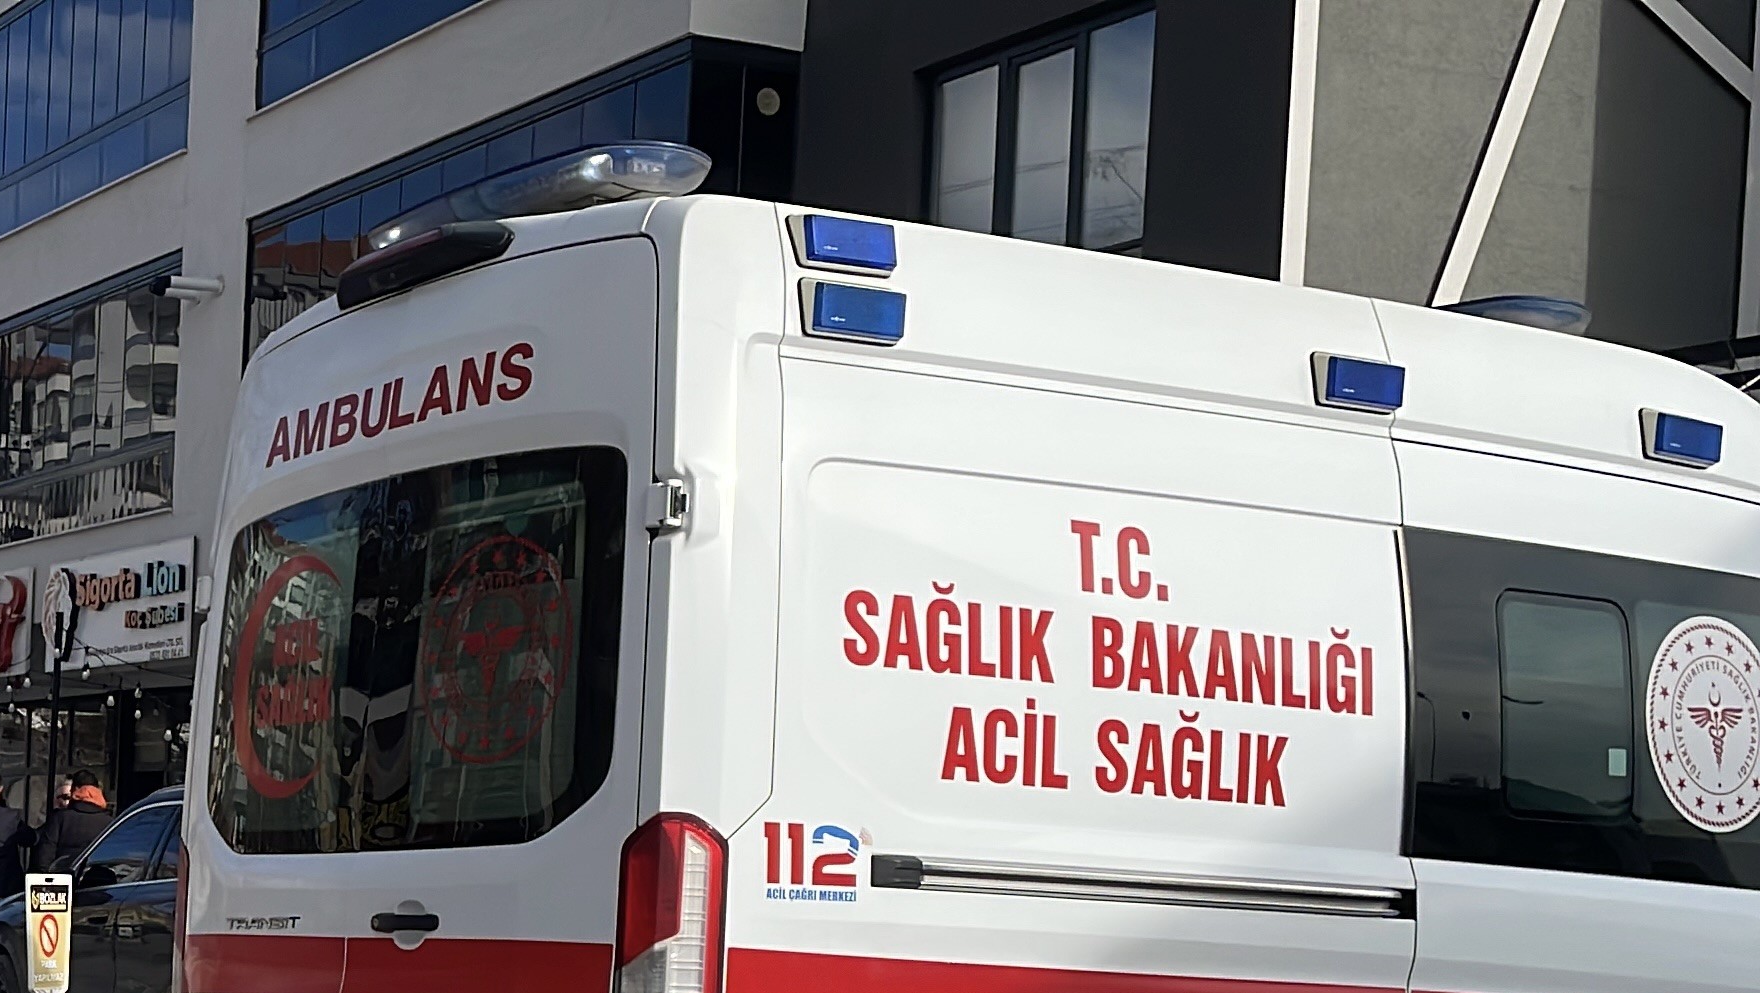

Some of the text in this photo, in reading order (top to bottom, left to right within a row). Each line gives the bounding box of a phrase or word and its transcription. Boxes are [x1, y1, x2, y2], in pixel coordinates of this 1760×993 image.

[265, 342, 534, 468] AMBULANS
[75, 561, 186, 611] Sigorta Lion
[1071, 519, 1167, 599] T.C.
[844, 580, 1372, 715] SAĞLIK BAKANLIĞI
[942, 697, 1288, 806] ACİL SAĞLIK
[764, 821, 859, 887] 112
[226, 916, 301, 930] TRANSIT
[766, 887, 857, 903] ACİL ÇAĞRI MERKEZİ
